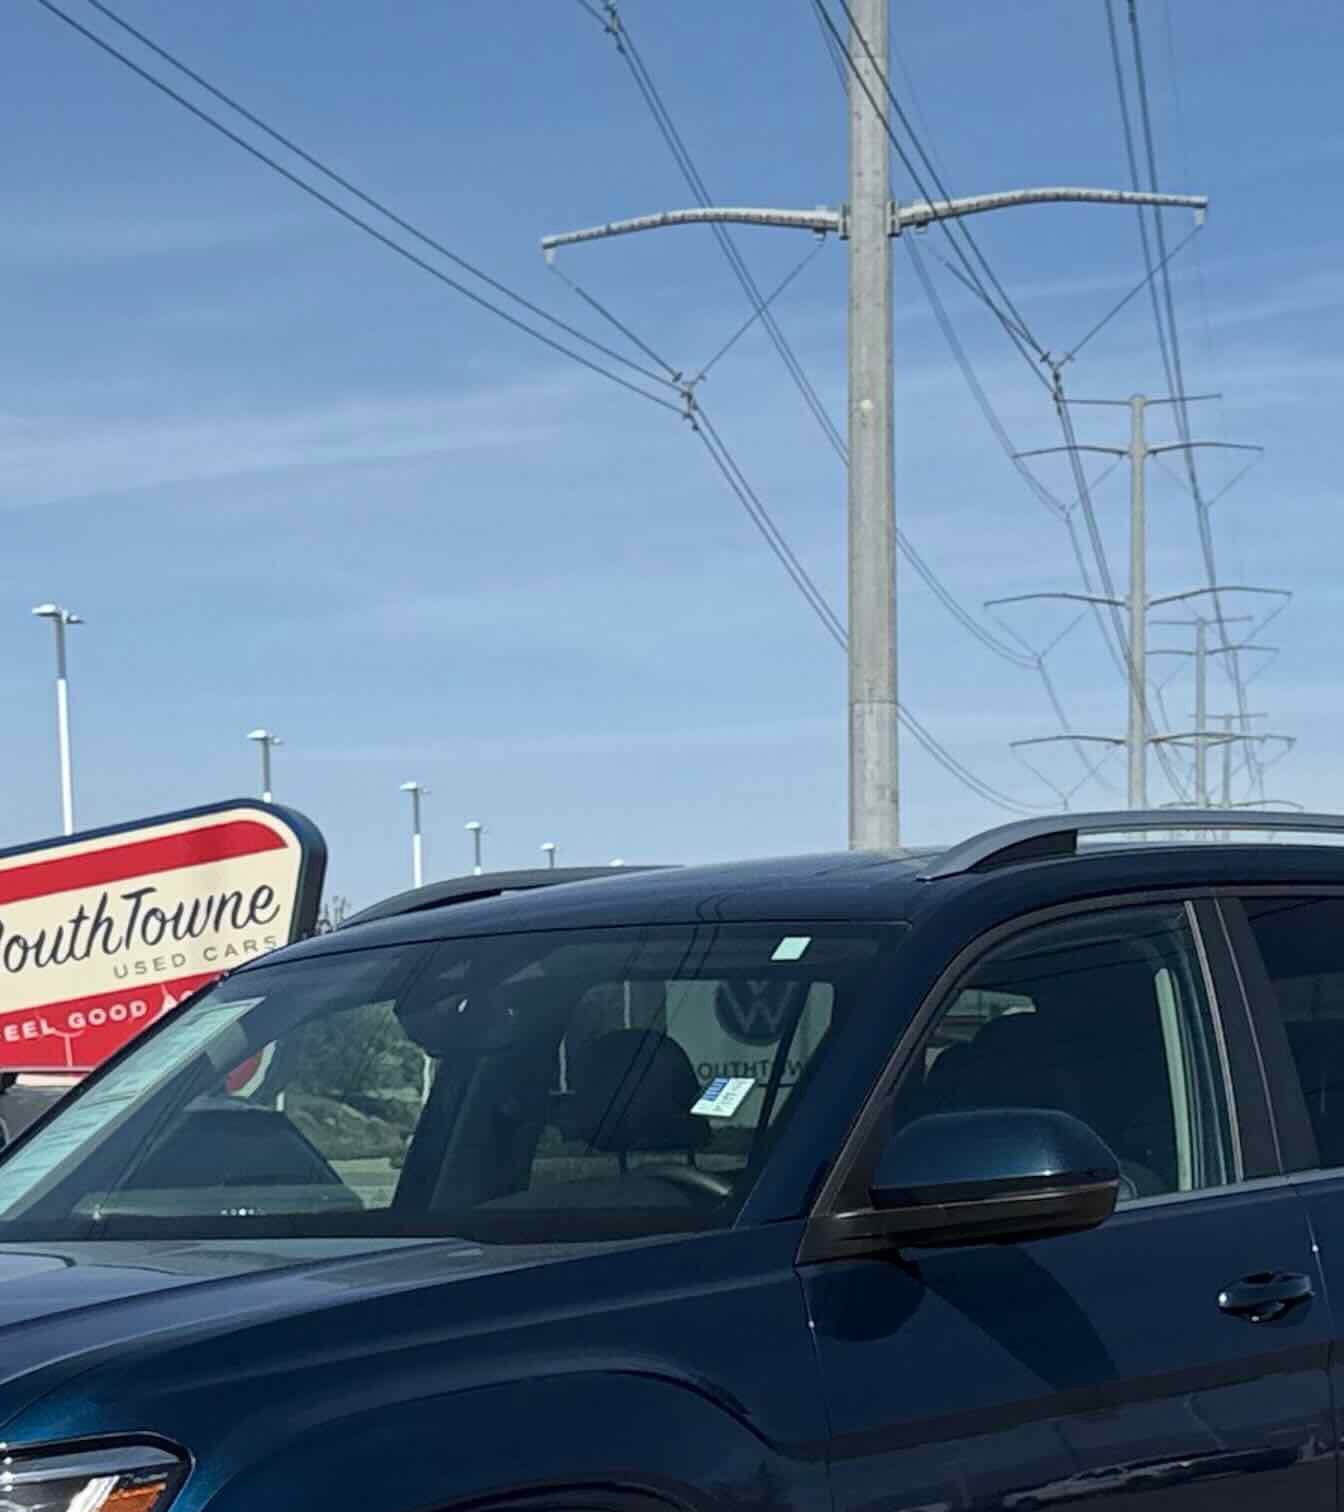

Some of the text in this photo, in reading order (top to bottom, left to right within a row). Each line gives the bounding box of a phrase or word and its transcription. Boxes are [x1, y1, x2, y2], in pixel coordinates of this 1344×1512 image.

[113, 935, 277, 979] USED CARS
[67, 1000, 148, 1030] GOOD
